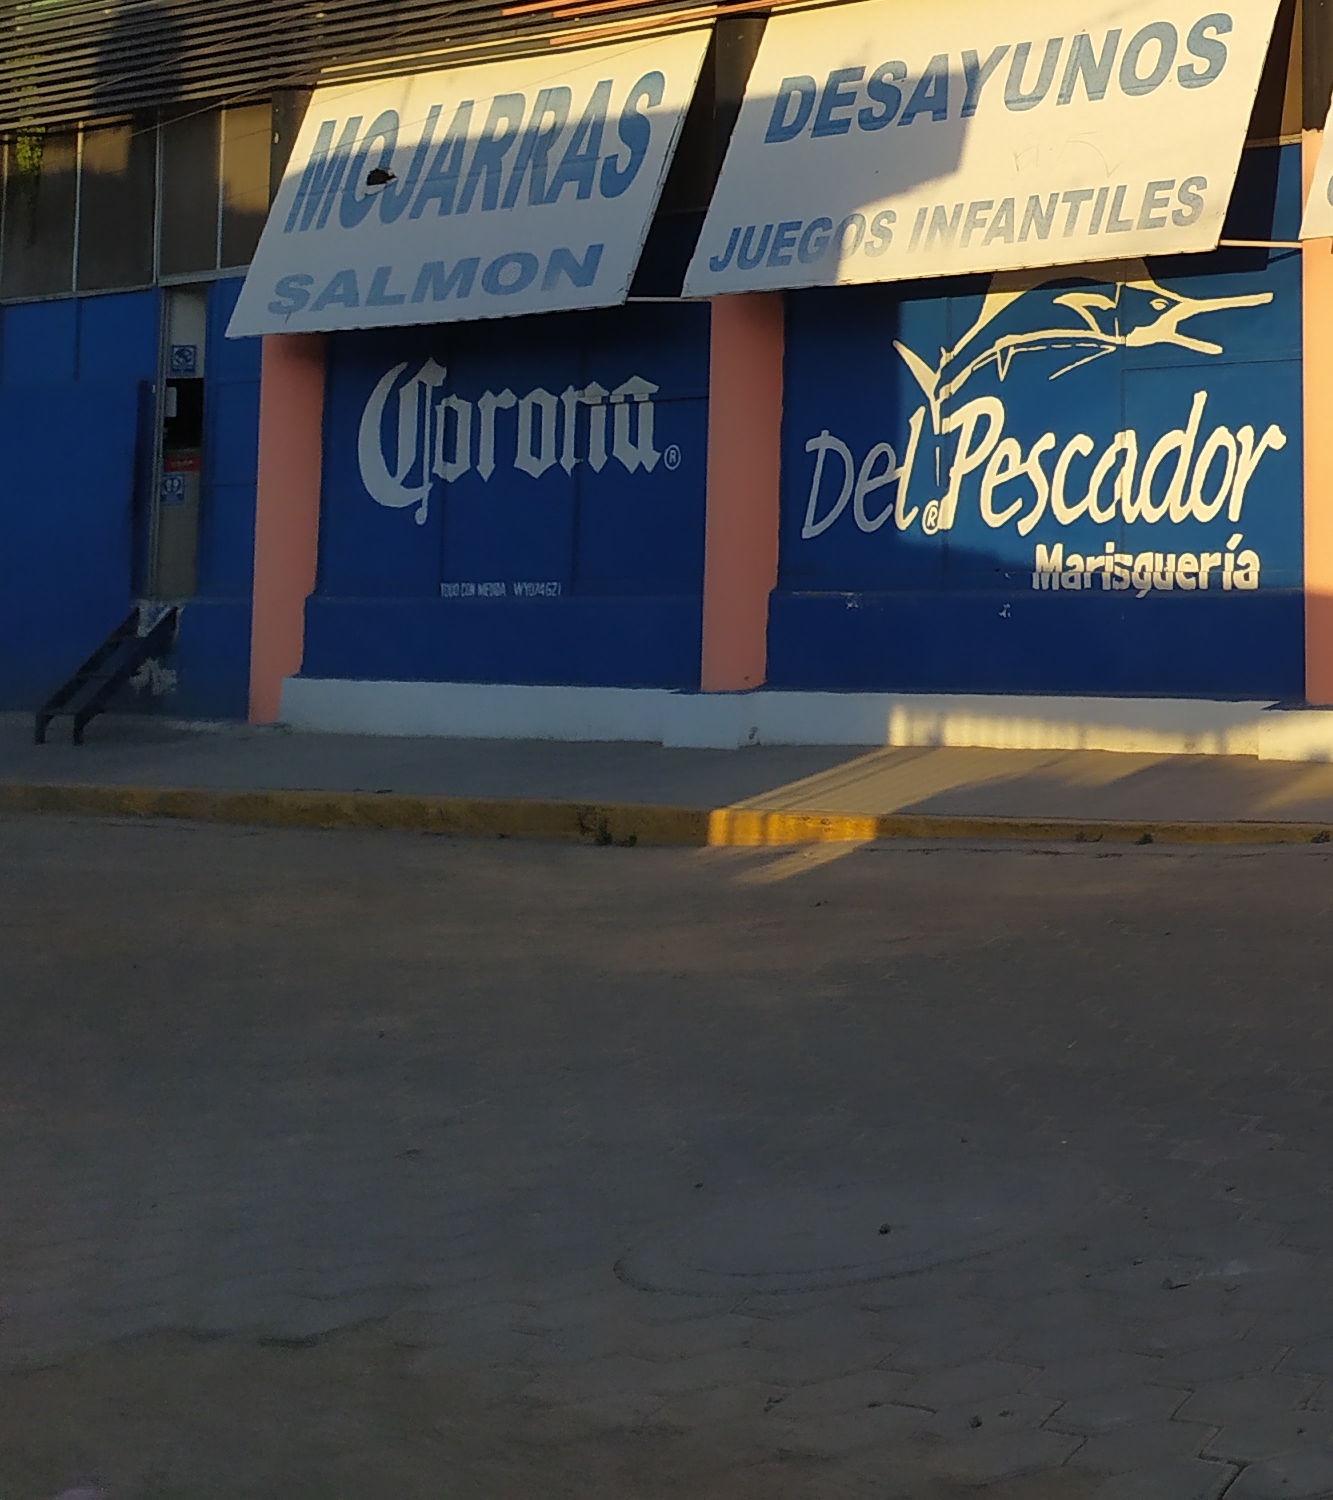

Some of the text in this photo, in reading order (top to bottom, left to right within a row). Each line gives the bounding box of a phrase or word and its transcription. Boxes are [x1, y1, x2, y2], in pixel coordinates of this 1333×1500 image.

[763, 12, 1234, 145] DESAYUNOS
[282, 69, 668, 234] MOJARRAS
[265, 244, 604, 319] SALMON
[709, 175, 1209, 272] JUEGOS INFANTILES
[357, 356, 665, 525] Corona
[801, 389, 1287, 540] Del Pescador
